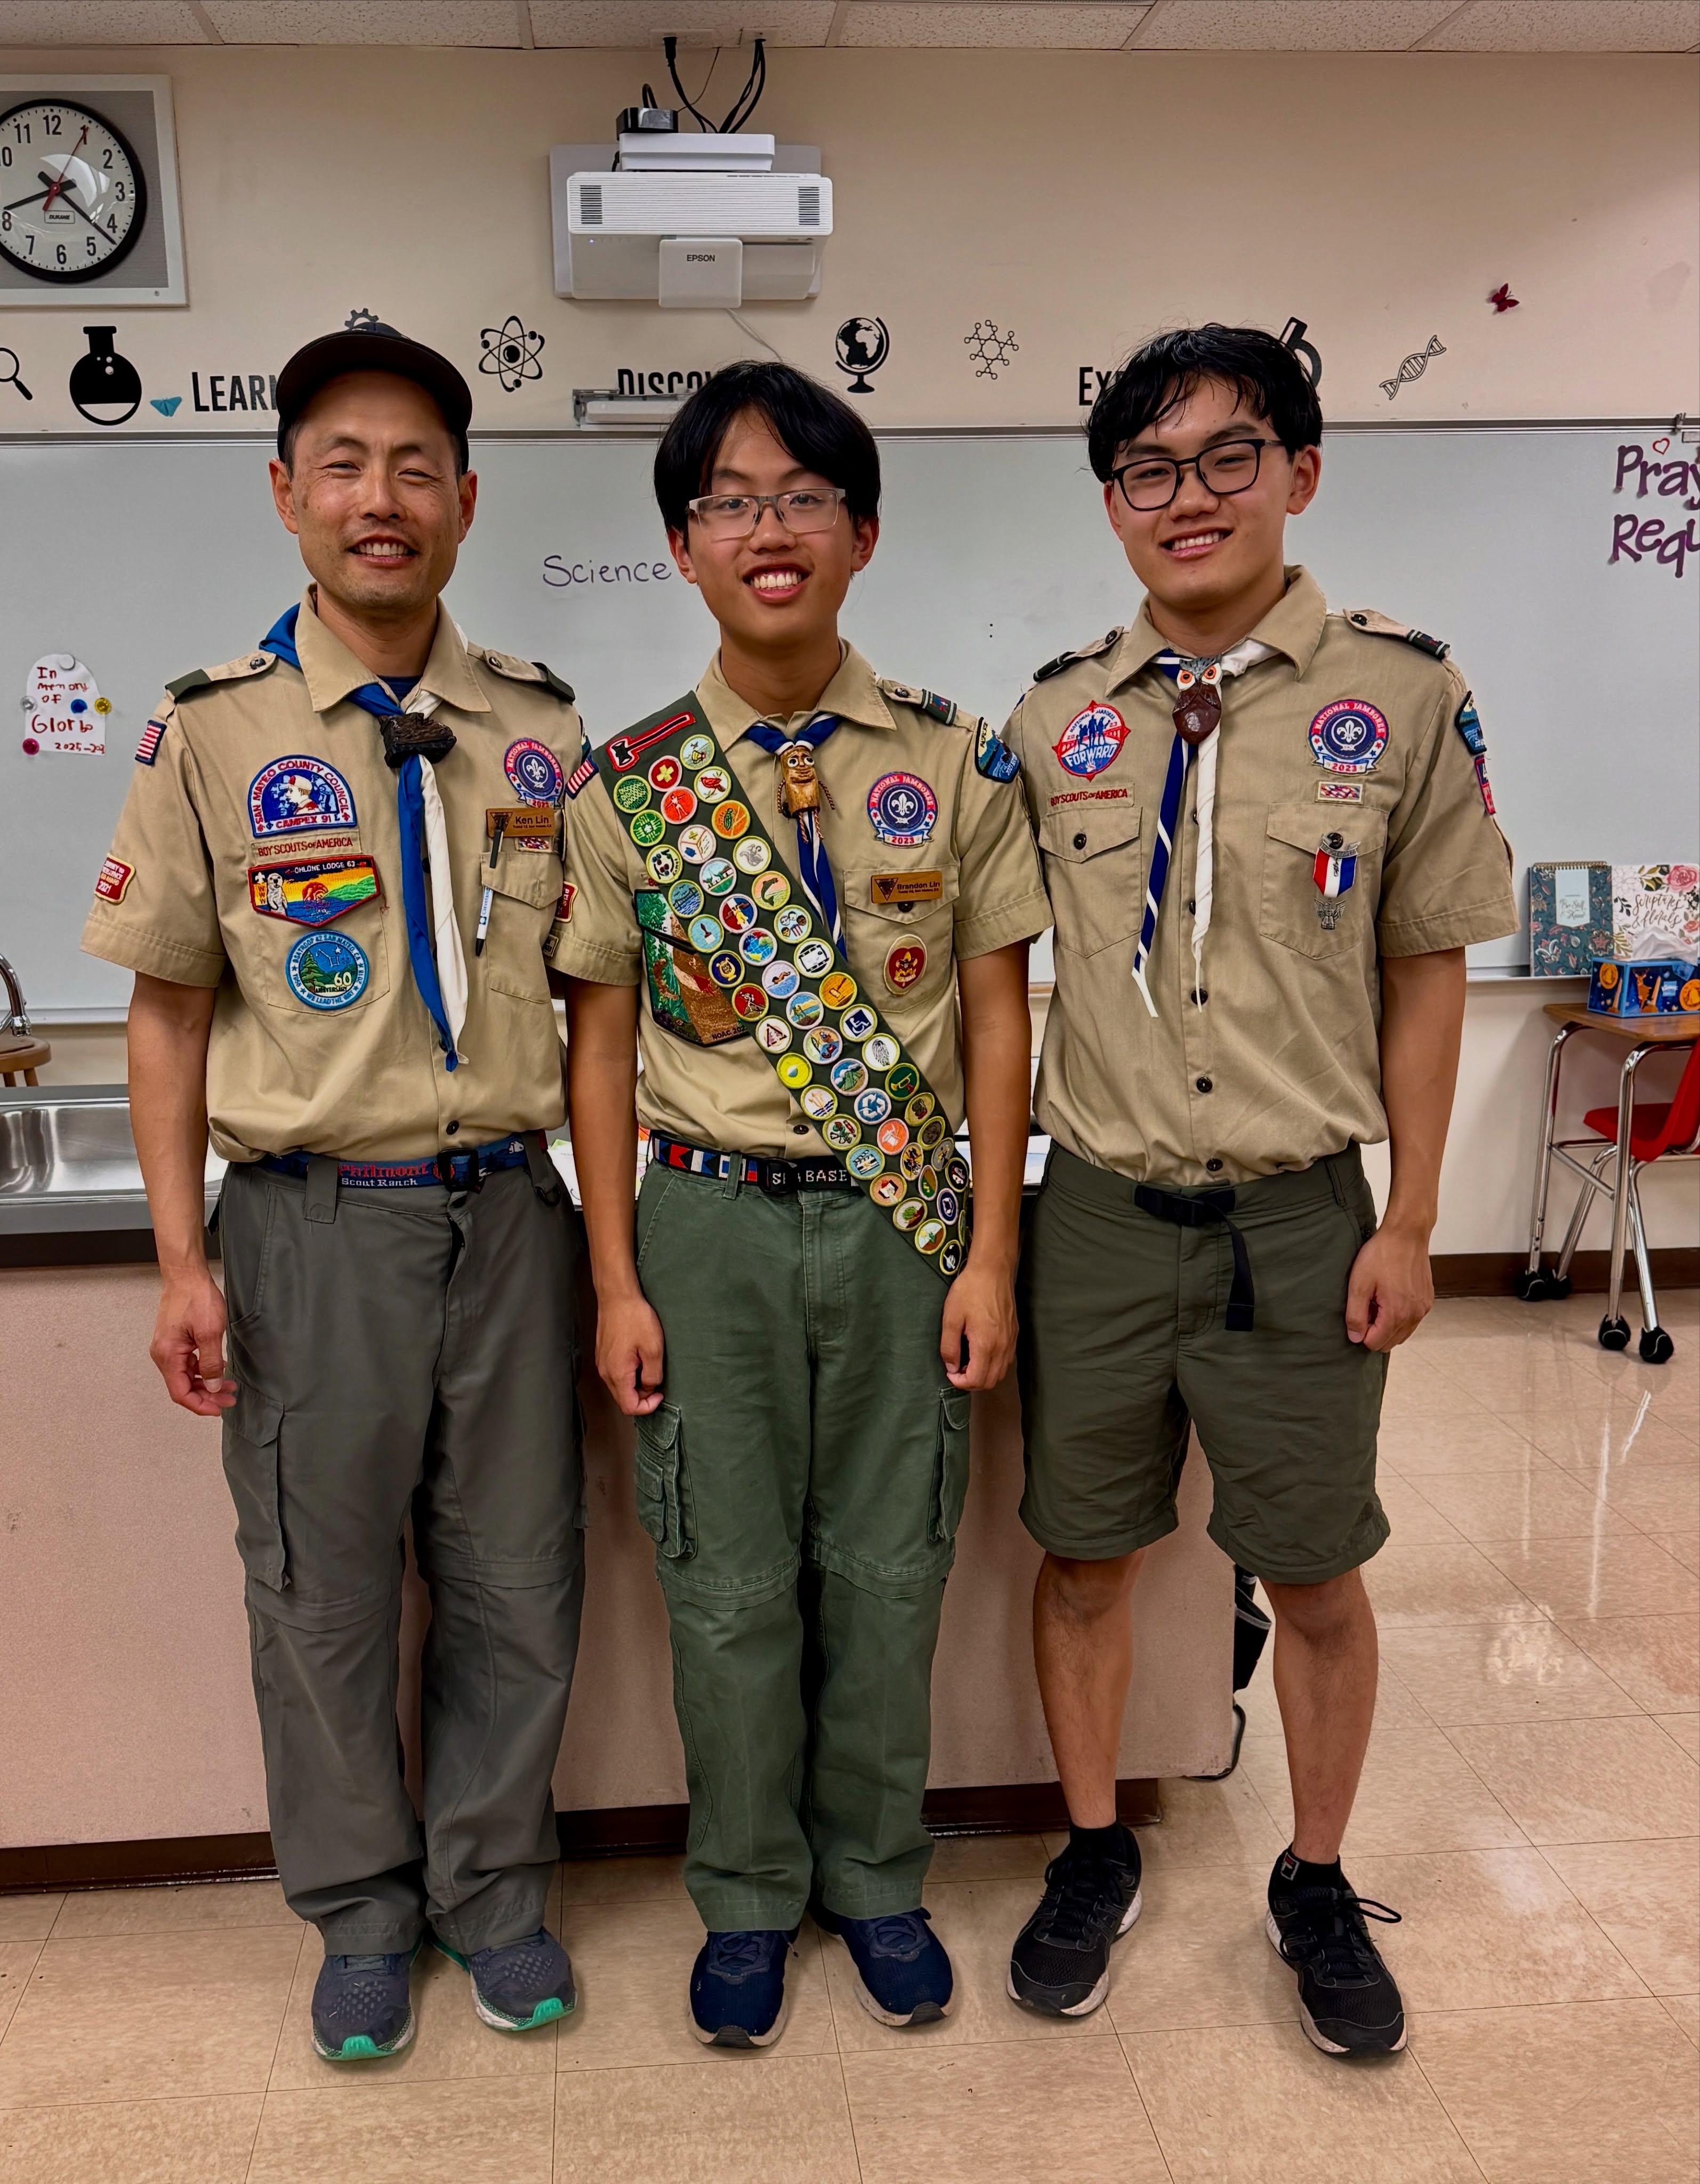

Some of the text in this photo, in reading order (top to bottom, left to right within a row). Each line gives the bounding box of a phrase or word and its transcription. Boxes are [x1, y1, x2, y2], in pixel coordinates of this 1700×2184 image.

[14, 123, 31, 143] 11
[43, 115, 62, 135] 12
[80, 124, 87, 144] 1
[0, 146, 12, 167] 0
[102, 149, 113, 169] 2
[115, 181, 125, 202] 3
[2, 211, 12, 231] 8
[107, 213, 118, 234] 4
[26, 235, 35, 255] 7
[57, 244, 67, 264] 6
[86, 237, 96, 256] 5
[618, 368, 720, 395] DISCO
[1079, 367, 1126, 406] EX
[543, 555, 672, 587] Science
[37, 667, 57, 679] In
[42, 694, 62, 704] of
[1315, 703, 1385, 733] NATIONAL JAMBOREE
[1065, 744, 1118, 767] FORWARD
[1332, 762, 1357, 772] 2023
[253, 760, 350, 824] SAN MATEO COUNTY COUNCIL
[871, 775, 933, 805] NATIONAL JAMBOREE
[1061, 791, 1088, 804] SCOUTS
[1095, 788, 1128, 799] AMERICA
[276, 816, 317, 829] CAMPEX
[535, 815, 549, 824] Lin
[258, 846, 272, 857] BOY
[273, 841, 308, 855] SCOUTS
[316, 837, 353, 849] AMERICA
[294, 864, 320, 874] OHLONE
[323, 862, 345, 870] LODGE
[1632, 893, 1685, 916] Scriptures
[1641, 909, 1682, 929] florals
[334, 971, 352, 987] 60
[712, 1030, 732, 1040] NOAC
[337, 1162, 429, 1178] Philmont
[805, 1169, 847, 1182] BASE
[341, 1177, 418, 1186] Scout Ranch
